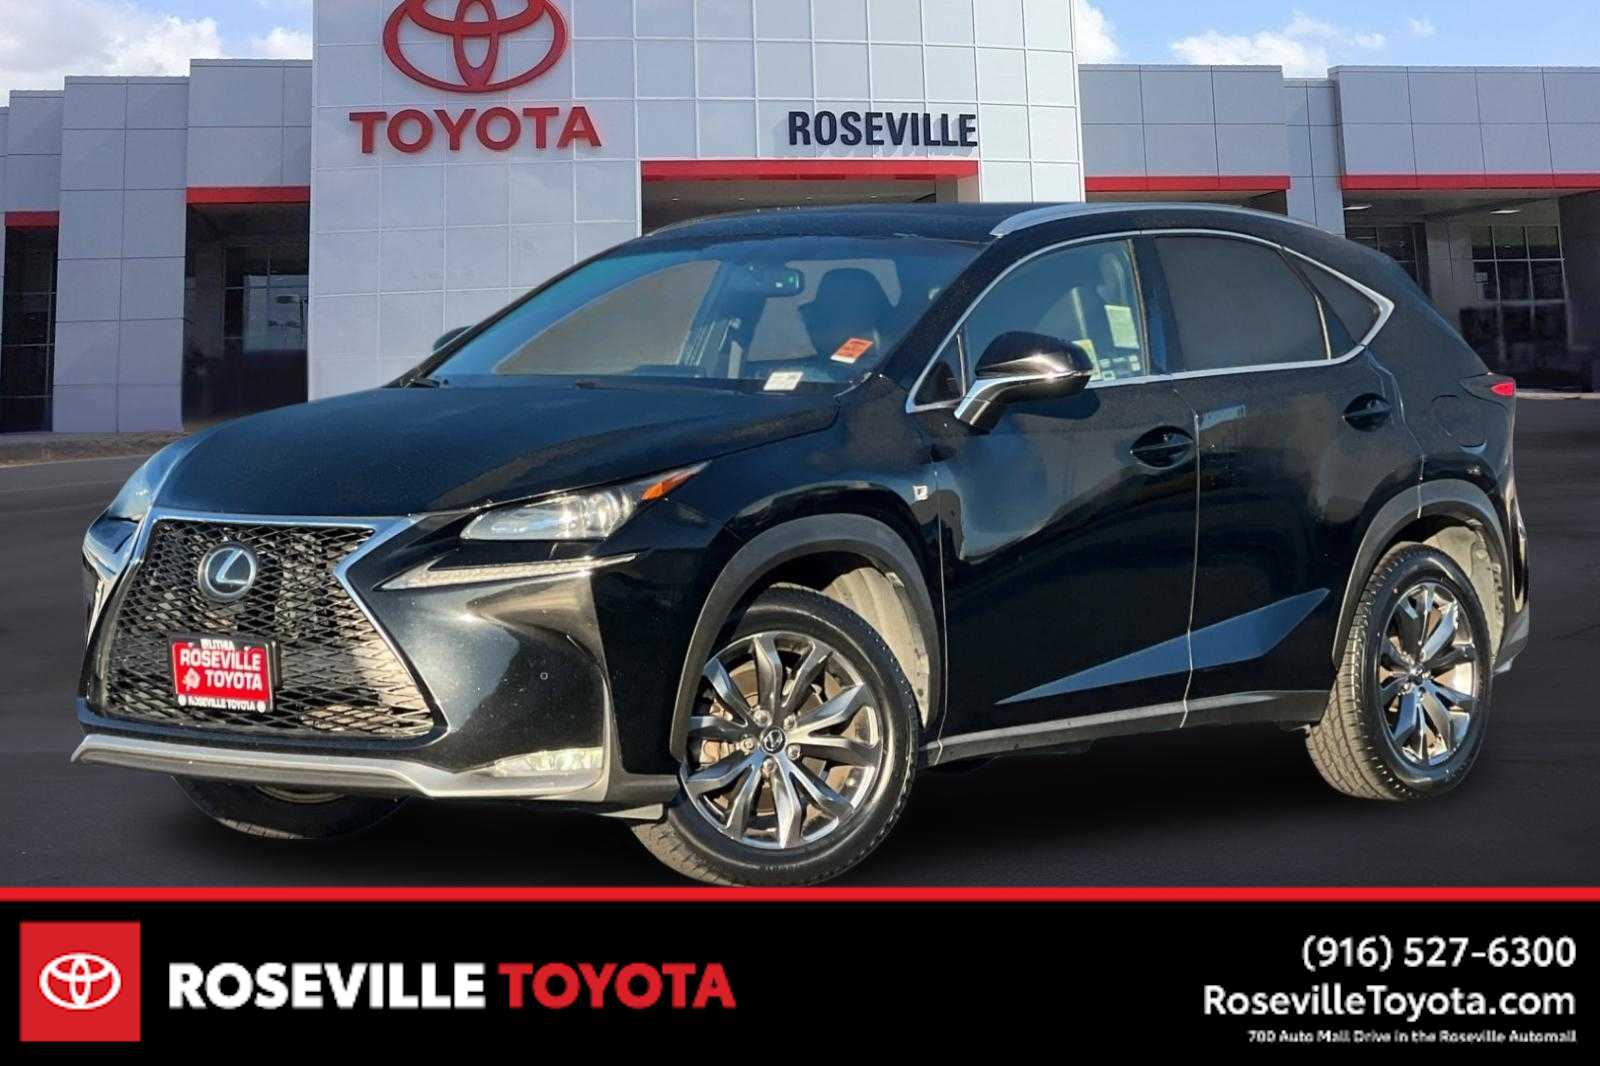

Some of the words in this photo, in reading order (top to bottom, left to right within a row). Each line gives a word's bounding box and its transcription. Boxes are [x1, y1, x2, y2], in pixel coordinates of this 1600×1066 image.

[349, 106, 603, 153] TOYOTA
[788, 110, 978, 147] ROSEVILLE
[180, 648, 262, 671] ROSEVILLE
[204, 669, 263, 691] TOYOTA
